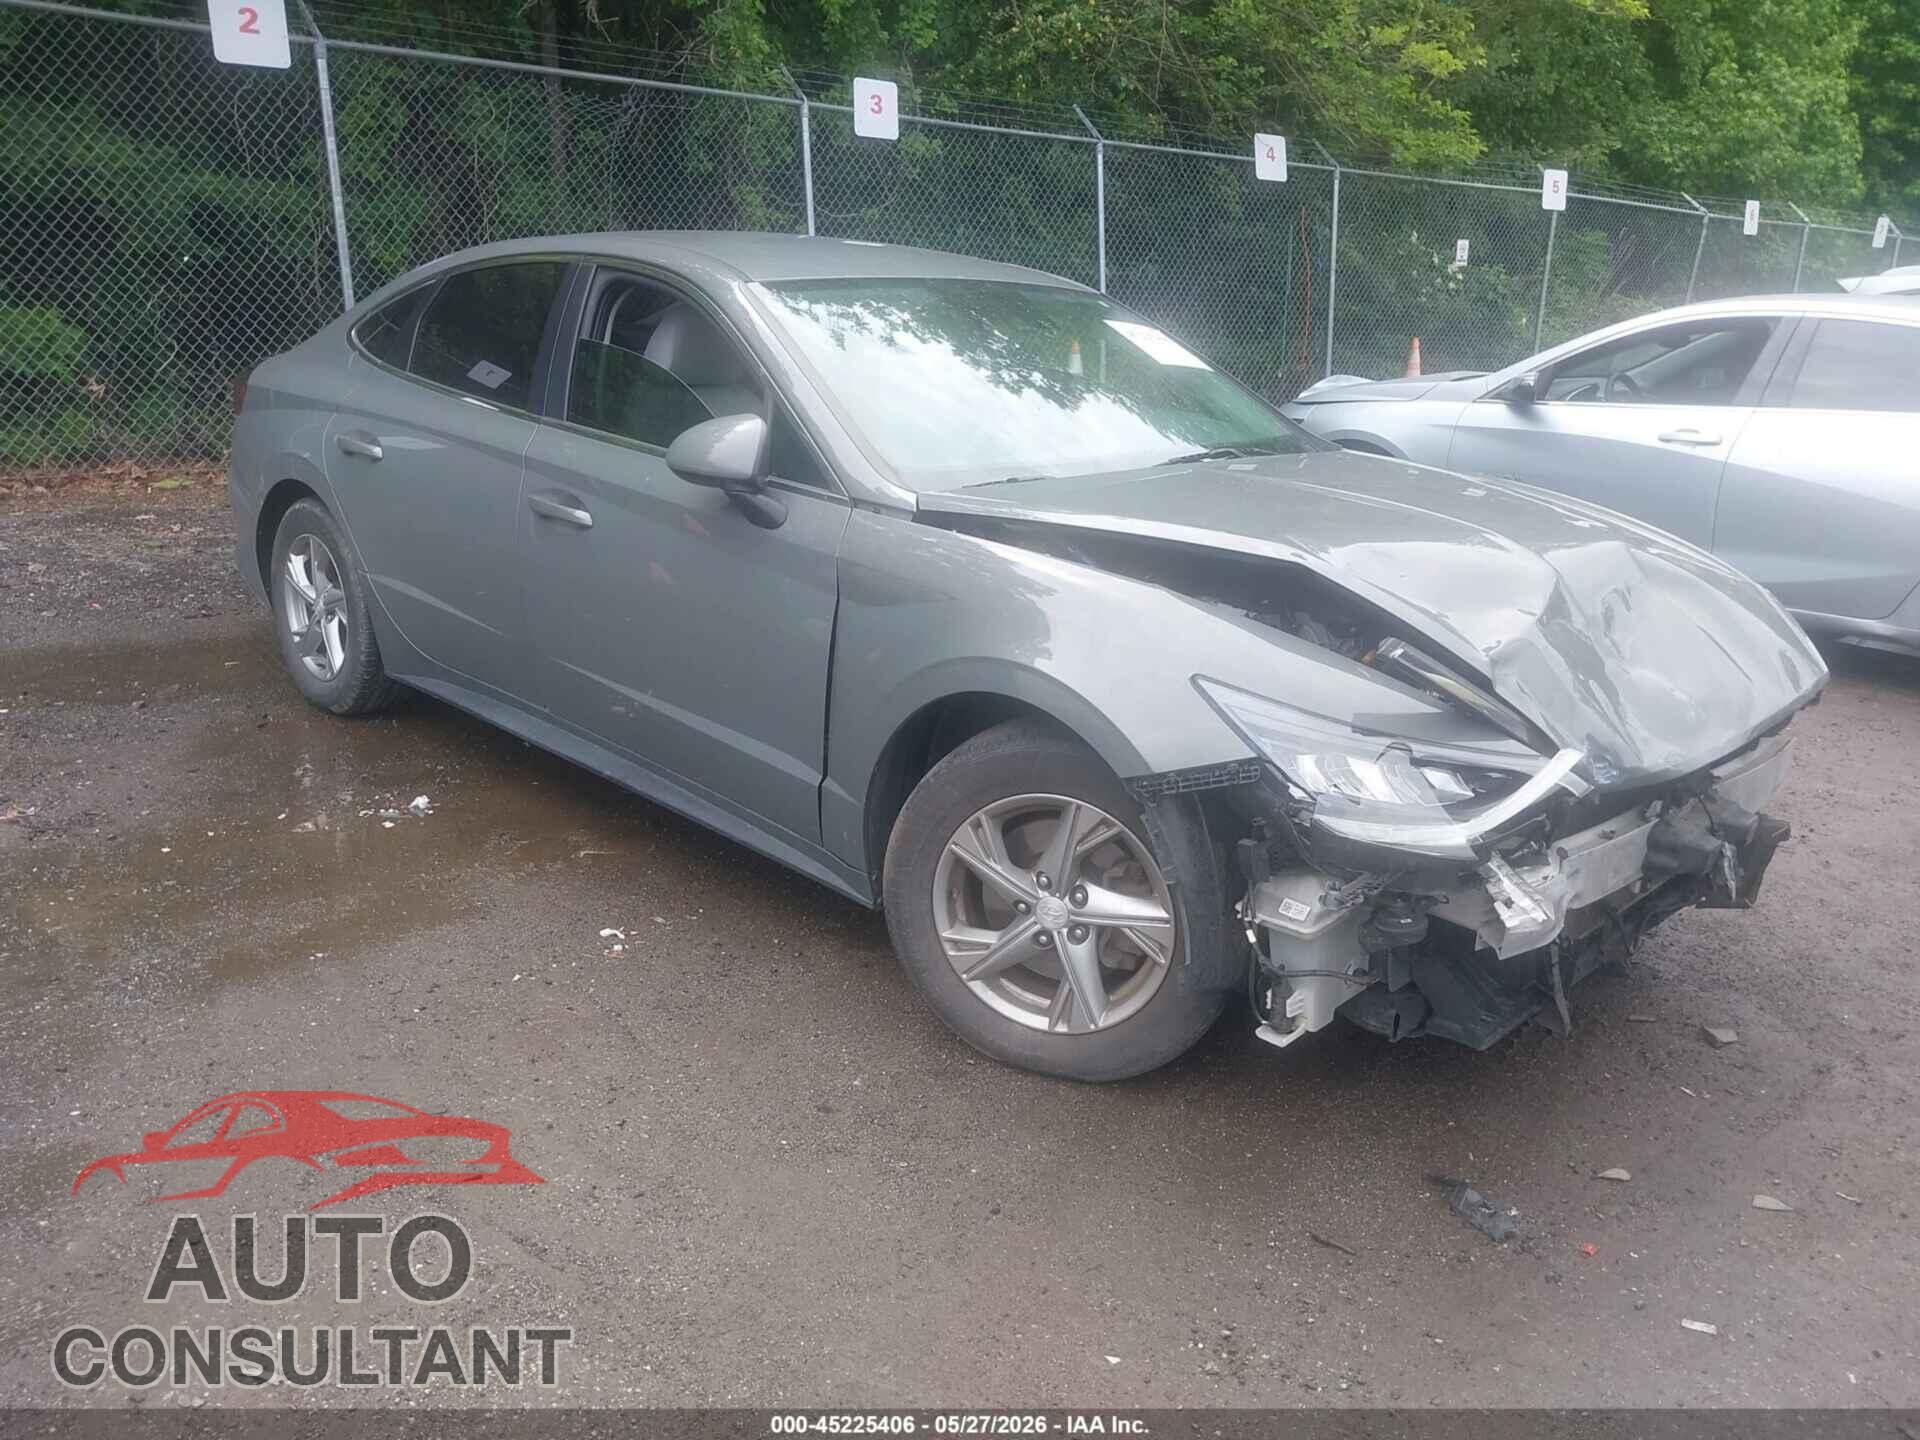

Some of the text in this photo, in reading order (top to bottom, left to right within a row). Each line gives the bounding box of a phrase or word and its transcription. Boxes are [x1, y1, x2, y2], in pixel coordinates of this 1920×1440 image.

[238, 7, 260, 34] 2
[870, 94, 882, 114] 3
[1266, 146, 1276, 162] 4
[1553, 180, 1560, 193] 5
